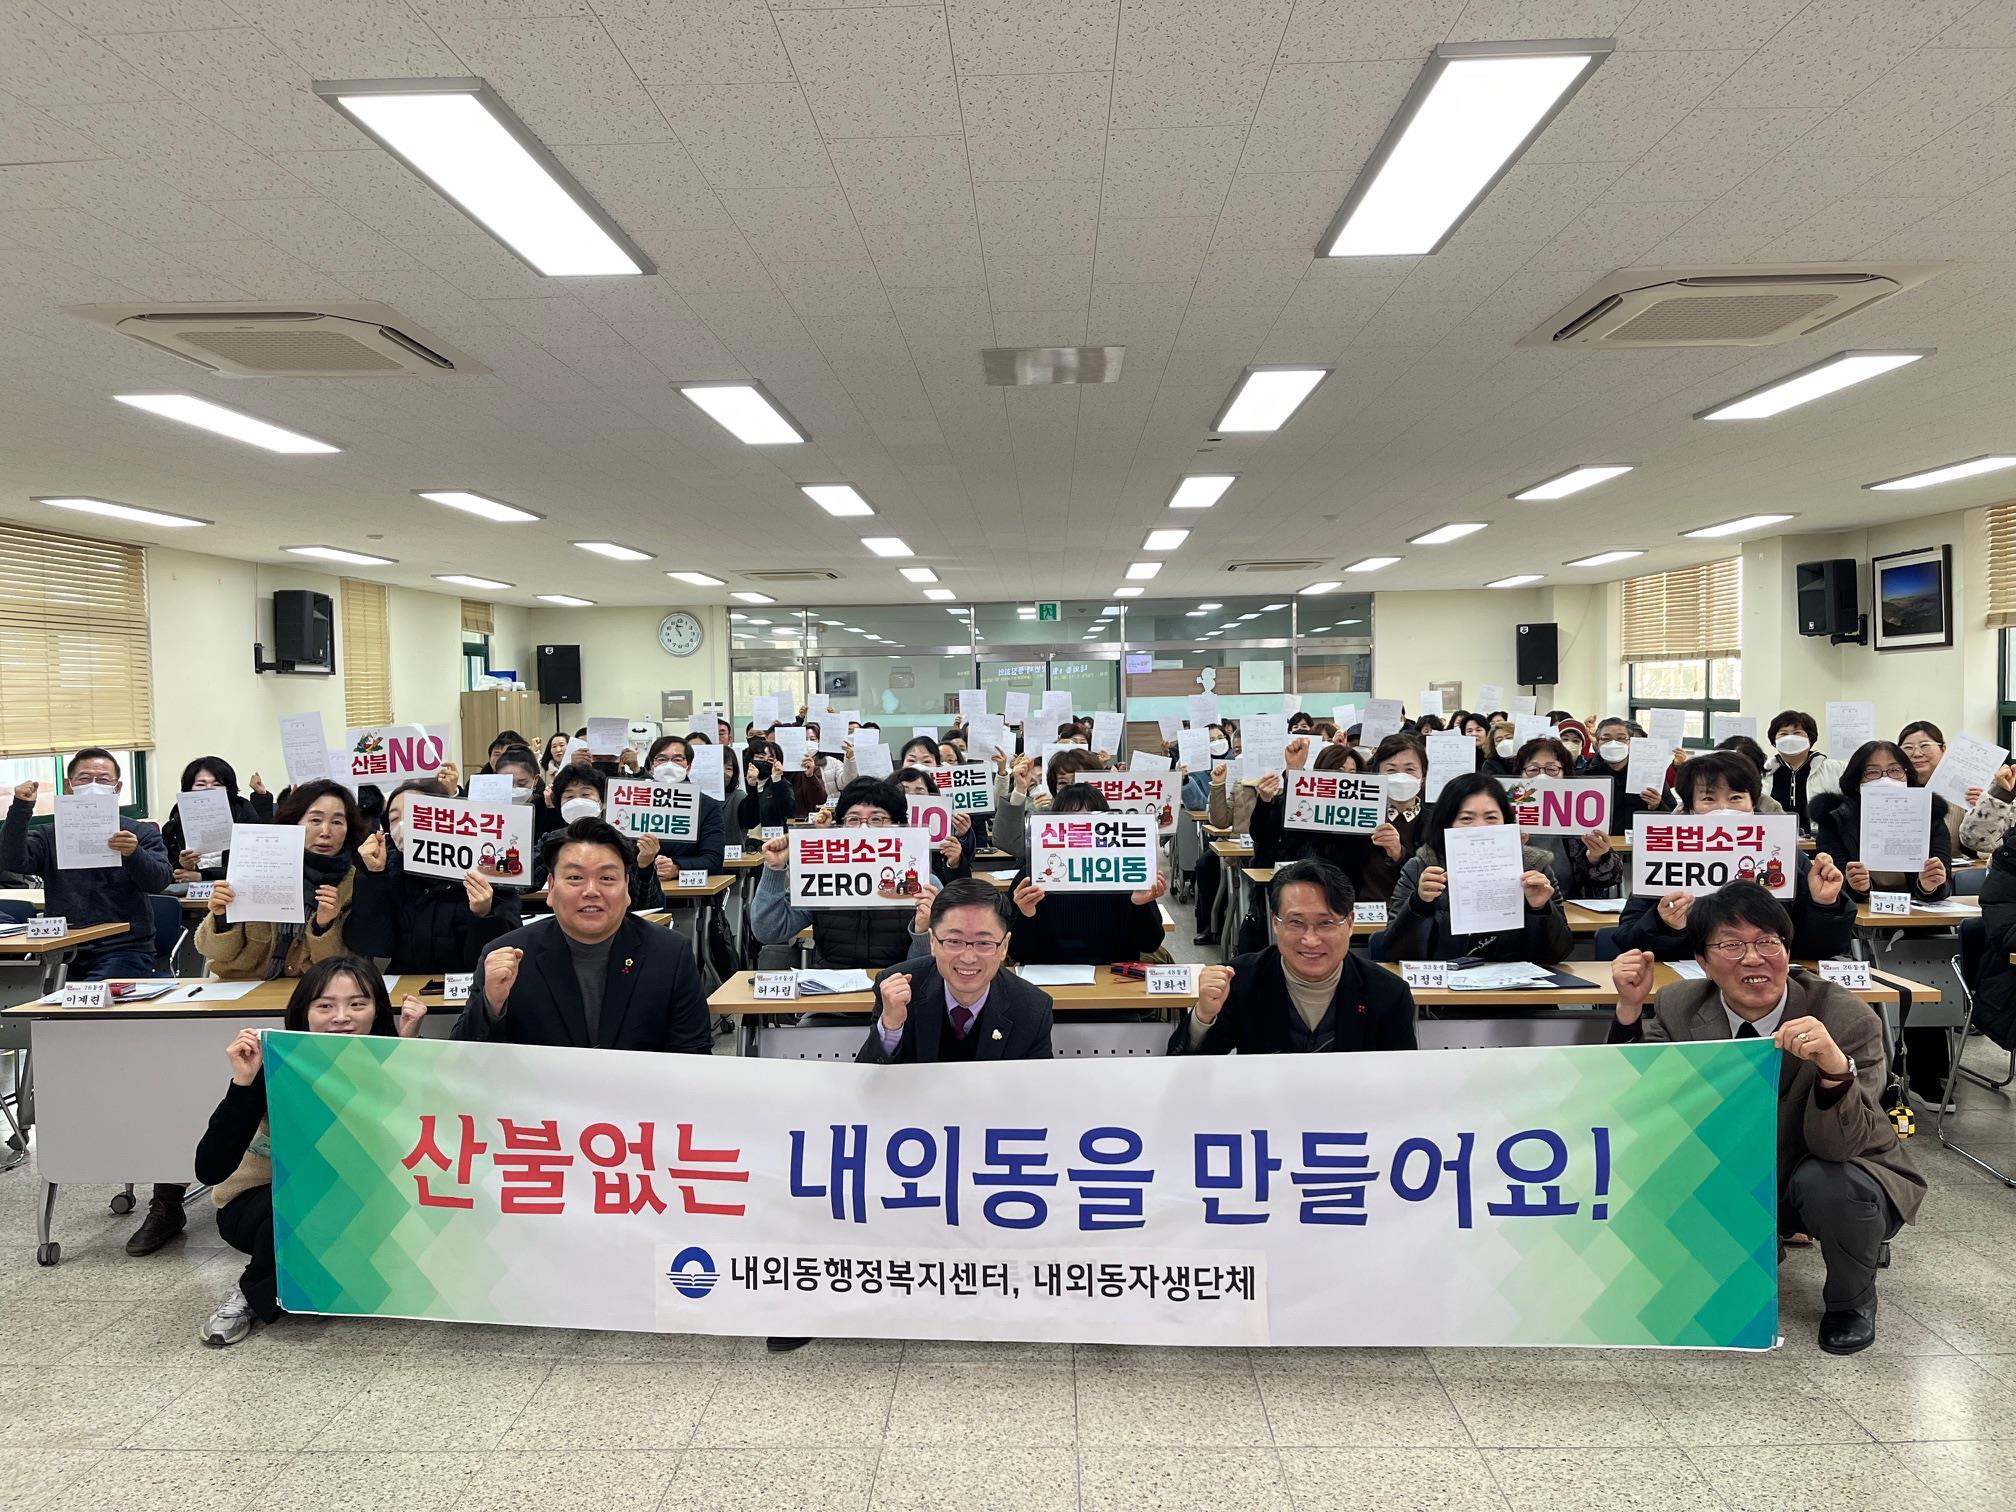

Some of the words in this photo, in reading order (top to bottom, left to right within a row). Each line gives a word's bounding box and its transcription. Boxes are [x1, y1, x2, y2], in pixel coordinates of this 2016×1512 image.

[352, 754, 388, 775] 산불
[388, 735, 444, 773] NO
[930, 769, 987, 789] 불없는
[1295, 776, 1380, 801] 산불없는
[614, 785, 693, 809] 산불없는
[946, 790, 989, 810] 외동
[1511, 805, 1540, 826] 불
[1542, 789, 1605, 828] NO
[412, 804, 505, 840] 불법소각
[631, 812, 691, 835] 내외동
[1313, 804, 1378, 828] 내외동
[1041, 821, 1147, 849] 산불없는
[1645, 825, 1766, 852] 불법소각
[412, 838, 474, 870] ZERO
[800, 838, 903, 864] 불법소각
[1067, 856, 1148, 883] 내외동
[1644, 861, 1729, 887] ZERO
[800, 872, 873, 897] ZERO
[758, 985, 791, 997] 허자림
[1151, 979, 1187, 991] 김화선
[1406, 973, 1443, 986] 이정영
[400, 1114, 750, 1217] 산불없는
[788, 1124, 1155, 1231] 내외동을
[1193, 1126, 1611, 1230] 만들어요!
[730, 1256, 1020, 1300] 내외동행정복지센터,
[1034, 1263, 1256, 1303] 내외동자생단체
